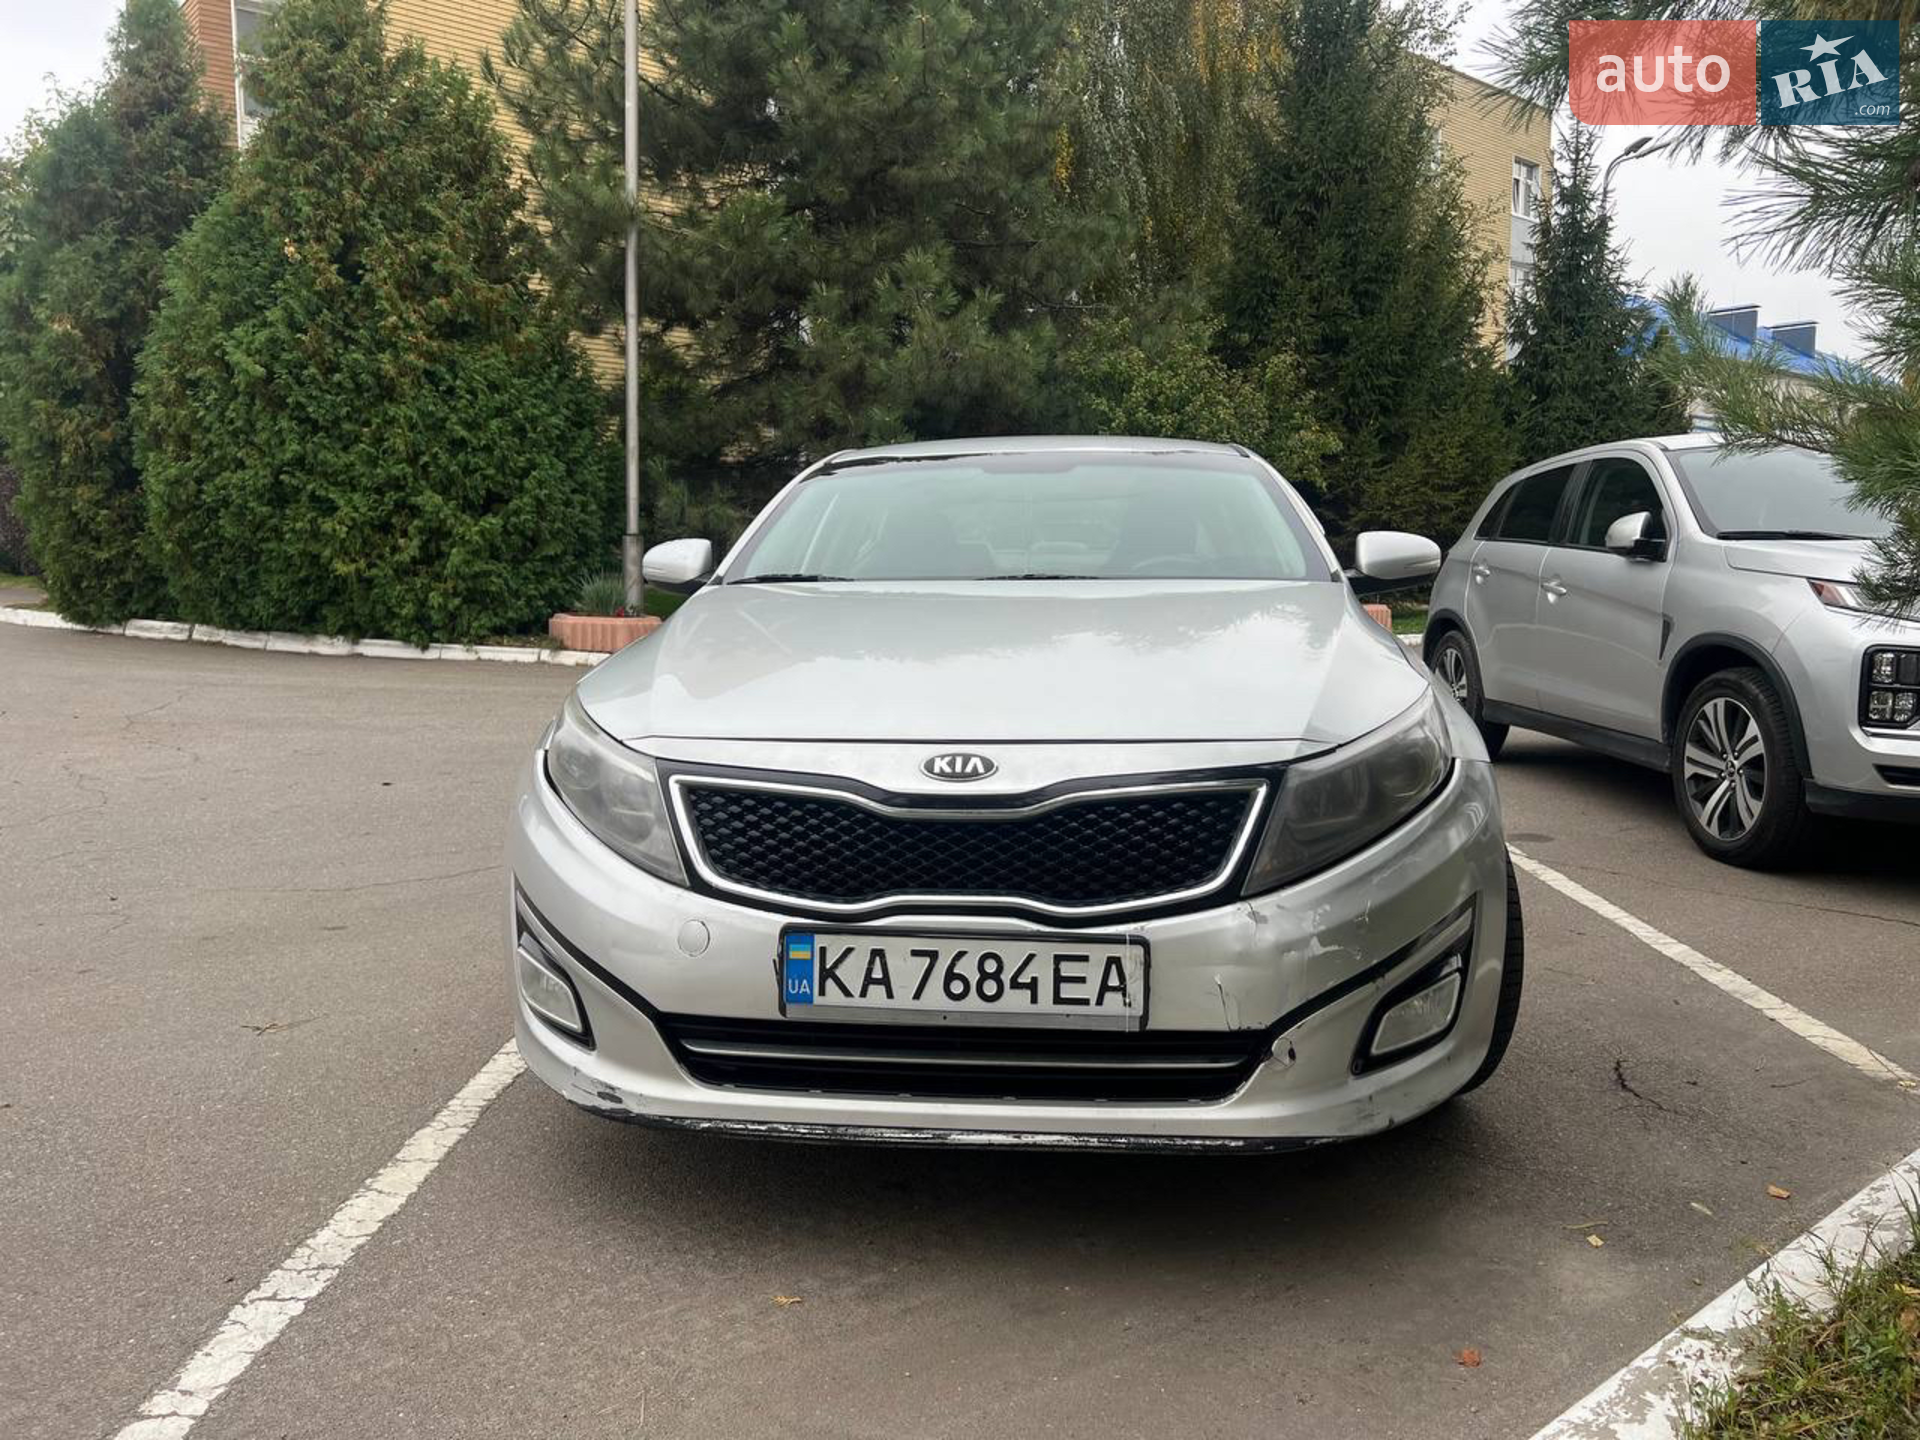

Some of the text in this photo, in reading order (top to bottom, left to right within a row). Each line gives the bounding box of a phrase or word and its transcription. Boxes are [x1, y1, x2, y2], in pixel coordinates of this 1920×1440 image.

[933, 755, 985, 773] KIA
[817, 946, 1132, 1007] KA 7684 EA
[788, 978, 811, 995] UA
